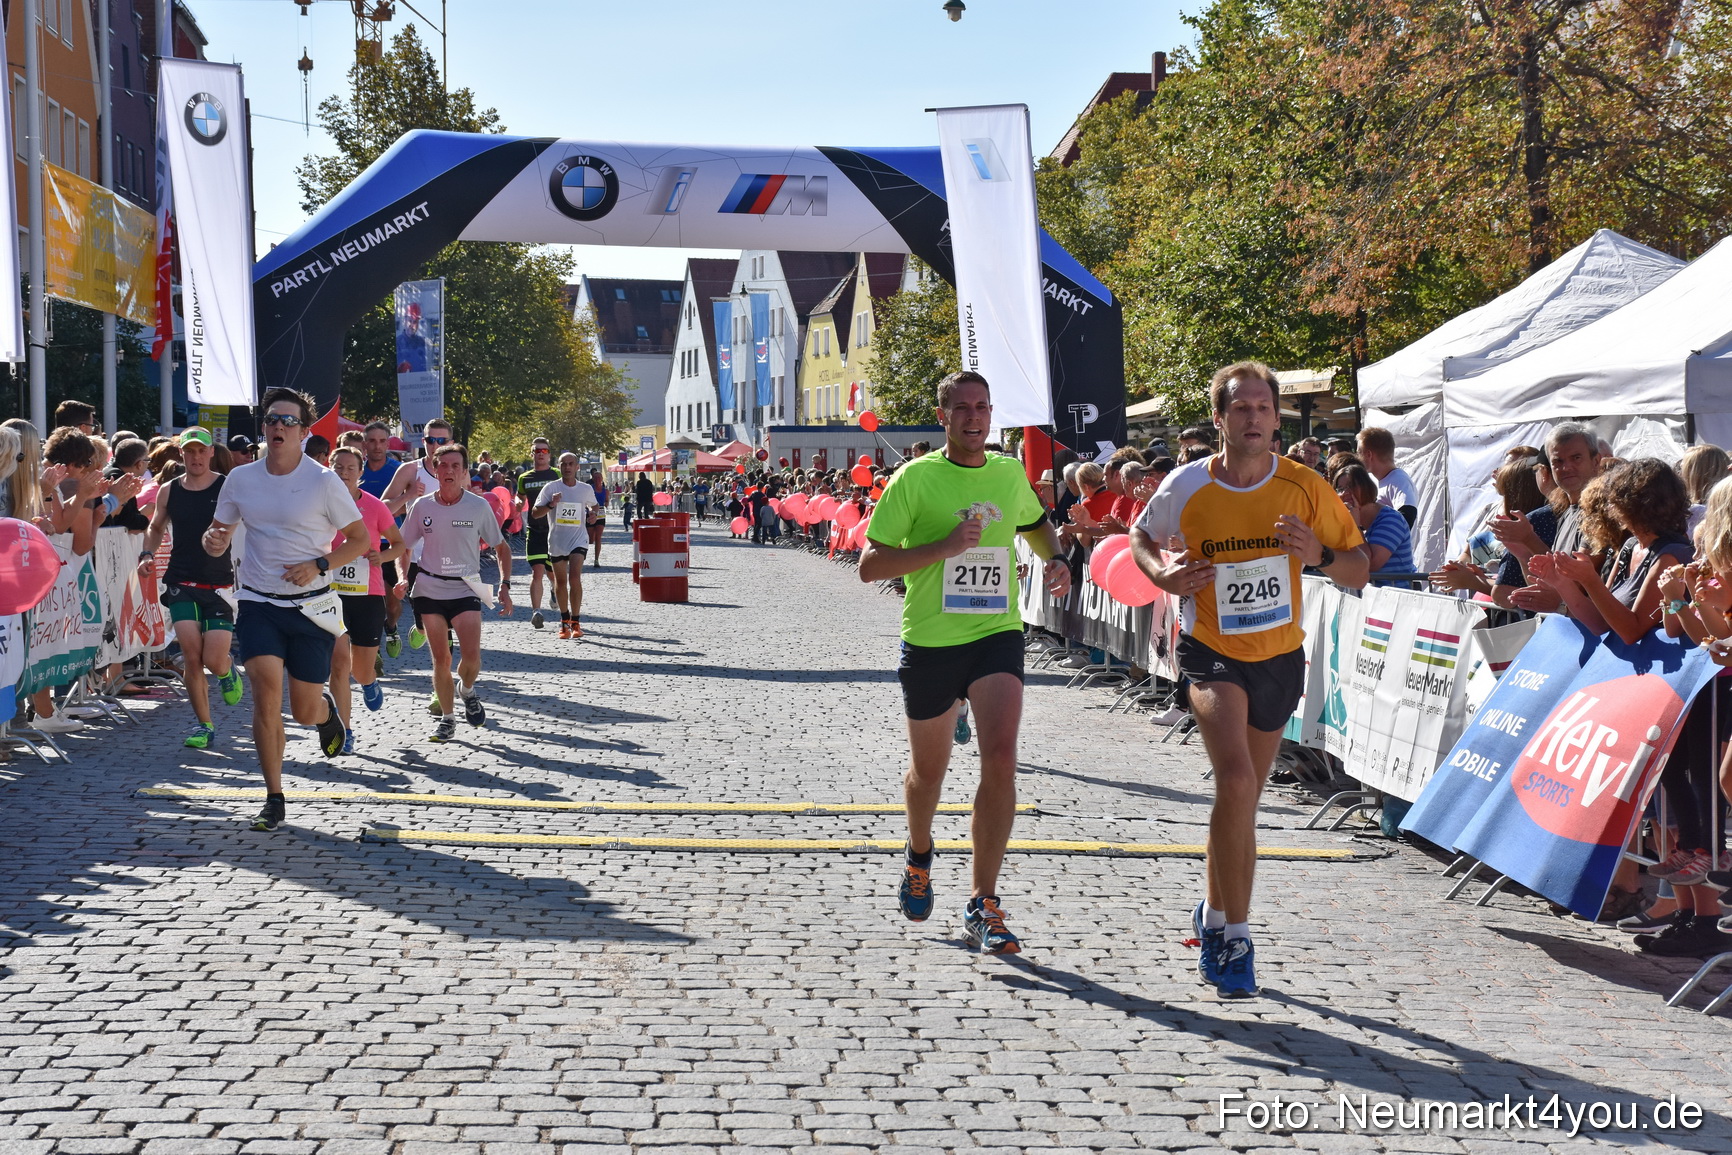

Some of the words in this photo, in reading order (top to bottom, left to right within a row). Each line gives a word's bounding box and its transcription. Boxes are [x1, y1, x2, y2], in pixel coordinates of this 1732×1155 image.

[556, 156, 613, 176] BMW
[270, 259, 333, 299] PARTL
[330, 201, 430, 266] NEUMARKT
[524, 480, 549, 489] BOC
[562, 508, 577, 517] 247
[1201, 536, 1284, 558] Continenta
[441, 557, 454, 565] 19.
[965, 552, 995, 561] BOCK
[339, 566, 356, 579] 48
[954, 565, 1001, 587] 2175
[1235, 565, 1268, 578] BOCK
[1226, 576, 1281, 605] 2246
[969, 597, 988, 607] Götz
[1251, 603, 1273, 611] Neumarkt
[1238, 611, 1277, 627] Matthias
[1508, 668, 1550, 692] STORE
[1478, 708, 1527, 738] ONLINE
[1523, 771, 1575, 808] SPORTS
